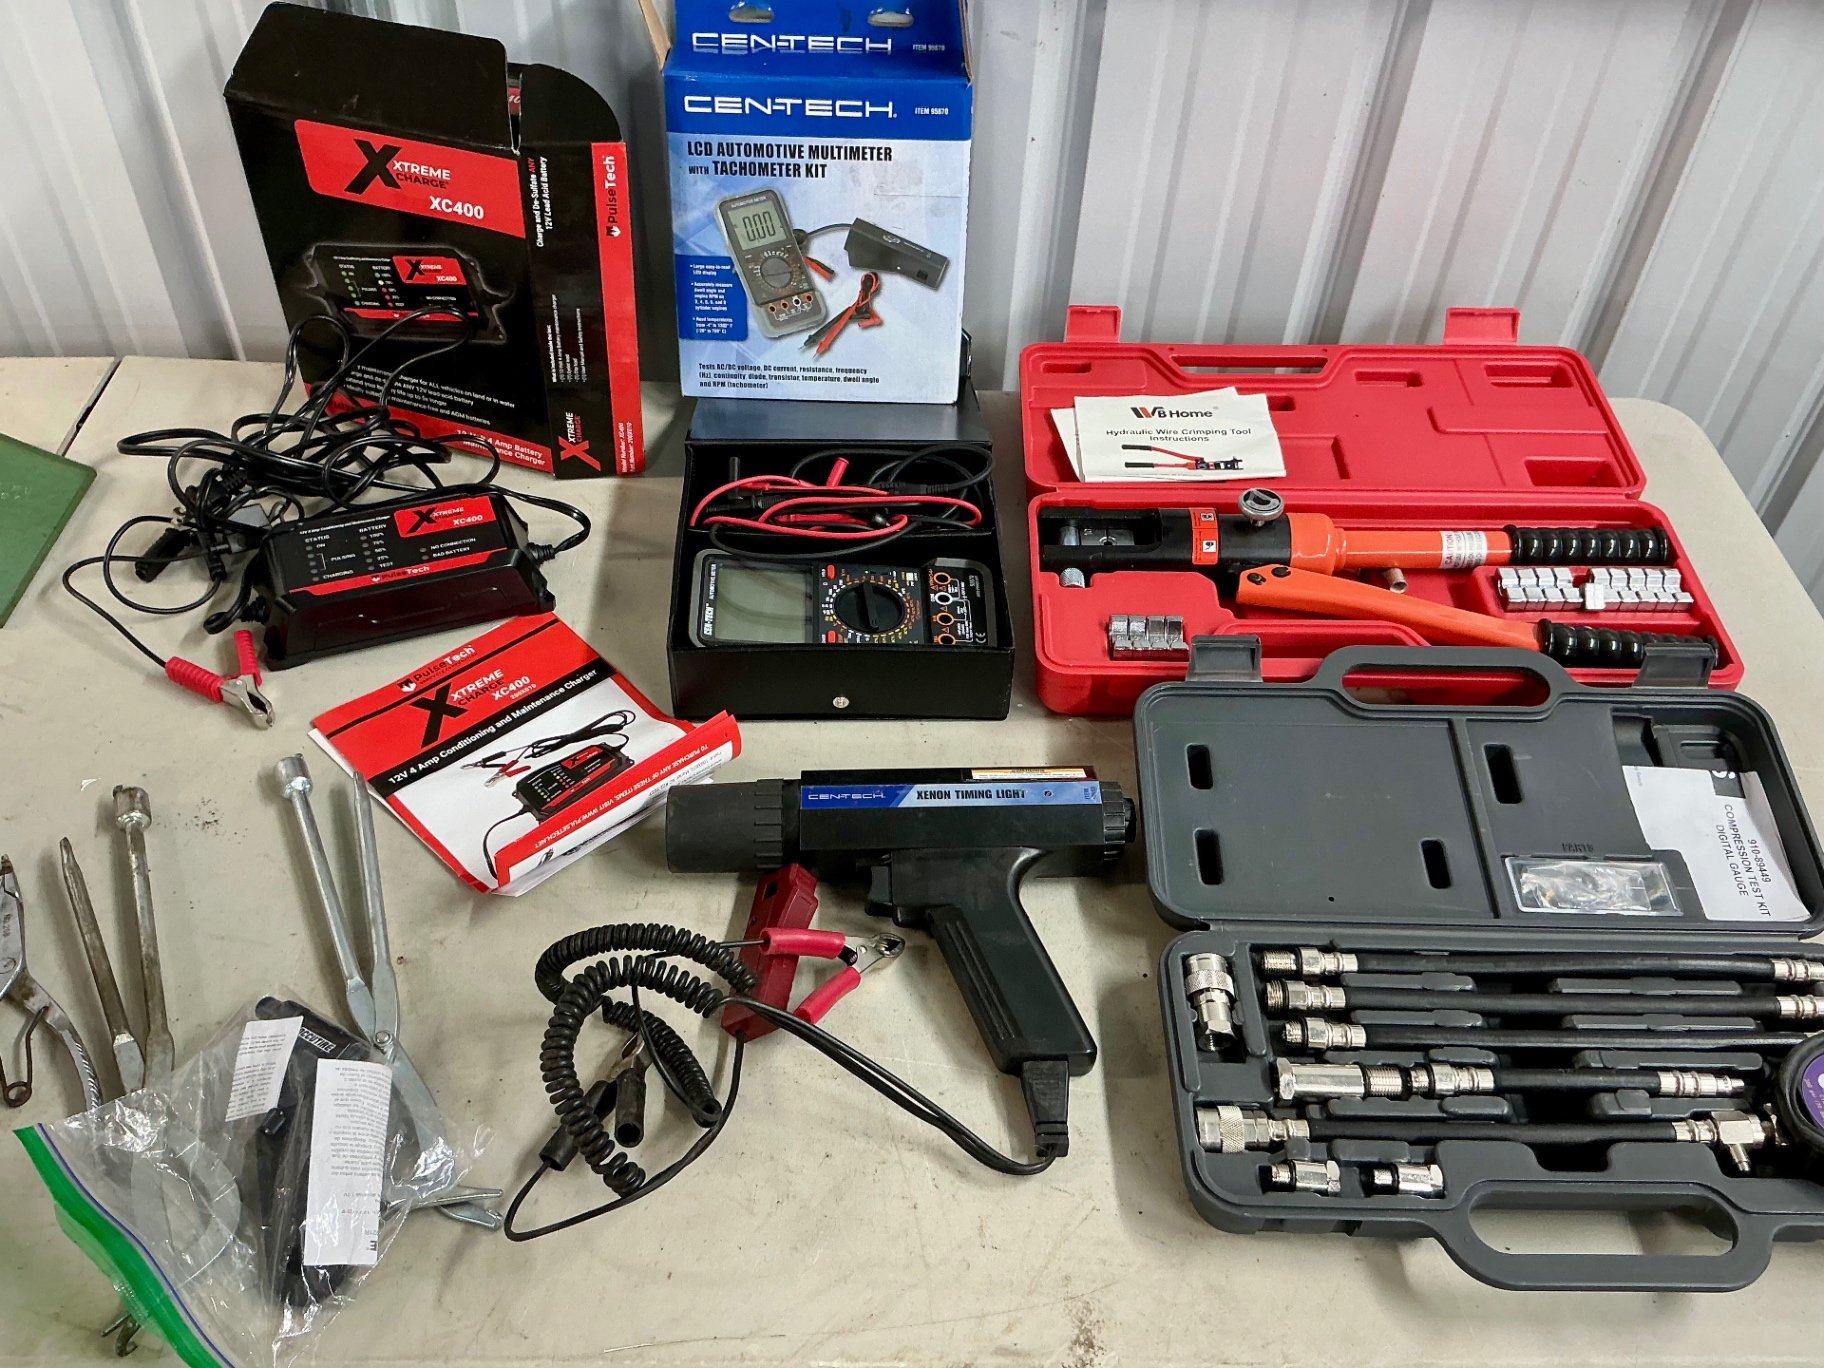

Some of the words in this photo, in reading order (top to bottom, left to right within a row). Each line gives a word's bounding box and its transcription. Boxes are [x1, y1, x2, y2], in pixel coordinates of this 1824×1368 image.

[914, 107, 929, 115] ITEM
[688, 141, 713, 157] LCD
[716, 142, 804, 160] AUTOMOTIVE
[808, 145, 893, 162] MULTIMETER
[393, 160, 451, 180] XTREME
[540, 156, 548, 182] Battery
[689, 165, 709, 175] WITH
[712, 161, 801, 178] TACHOMETER
[805, 164, 828, 179] KIT
[395, 172, 450, 189] CHARGE
[541, 183, 550, 199] Acid
[603, 155, 618, 224] PulseTech
[429, 195, 485, 220] XC400
[543, 200, 552, 217] Lead
[533, 210, 541, 223] and
[545, 218, 553, 230] 12V
[536, 224, 544, 247] Charge
[699, 363, 715, 371] Tests
[836, 367, 867, 375] frequency
[801, 375, 842, 383] temperature,
[441, 385, 464, 395] vehicles
[500, 400, 515, 408] water
[453, 395, 474, 406] battery
[465, 412, 491, 425] batteries
[1169, 410, 1213, 418] Home
[565, 411, 574, 443] XTREME
[1106, 428, 1153, 436] Hydraulic
[1181, 428, 1227, 436] Crimping
[494, 440, 513, 450] Amp
[514, 444, 543, 459] Battery
[515, 451, 546, 466] Charger
[432, 507, 465, 518] XTREME
[453, 514, 483, 526] XC400
[358, 524, 387, 533] BATTERY
[304, 534, 330, 543] STATUS
[445, 547, 470, 555] BATTERY
[413, 645, 475, 681] PulseTech
[450, 669, 504, 702] XTREME
[458, 678, 505, 706] CHARGE
[491, 676, 530, 701] XC400
[388, 769, 409, 784] 12V
[409, 765, 417, 774] 4
[418, 755, 440, 771] Amp
[439, 724, 496, 758] Conditioning
[494, 715, 513, 728] and
[512, 688, 565, 719] Maintenance
[564, 669, 597, 690] Charger
[700, 744, 708, 752] TO
[672, 749, 701, 769] PURCHASE
[652, 772, 660, 780] OF
[659, 765, 672, 775] ANY
[633, 777, 651, 791] THESE
[917, 790, 951, 800] XENON
[955, 790, 992, 799] TIMING
[996, 789, 1025, 799] LIGHT
[599, 799, 614, 810] VISIT
[1716, 824, 1731, 861] DIGITAL
[1730, 863, 1749, 896] GAUGE
[1724, 804, 1753, 873] COMPRESSION
[1748, 877, 1763, 902] TEST
[1758, 902, 1771, 916] KIT
[1748, 839, 1771, 883] 910-89449
